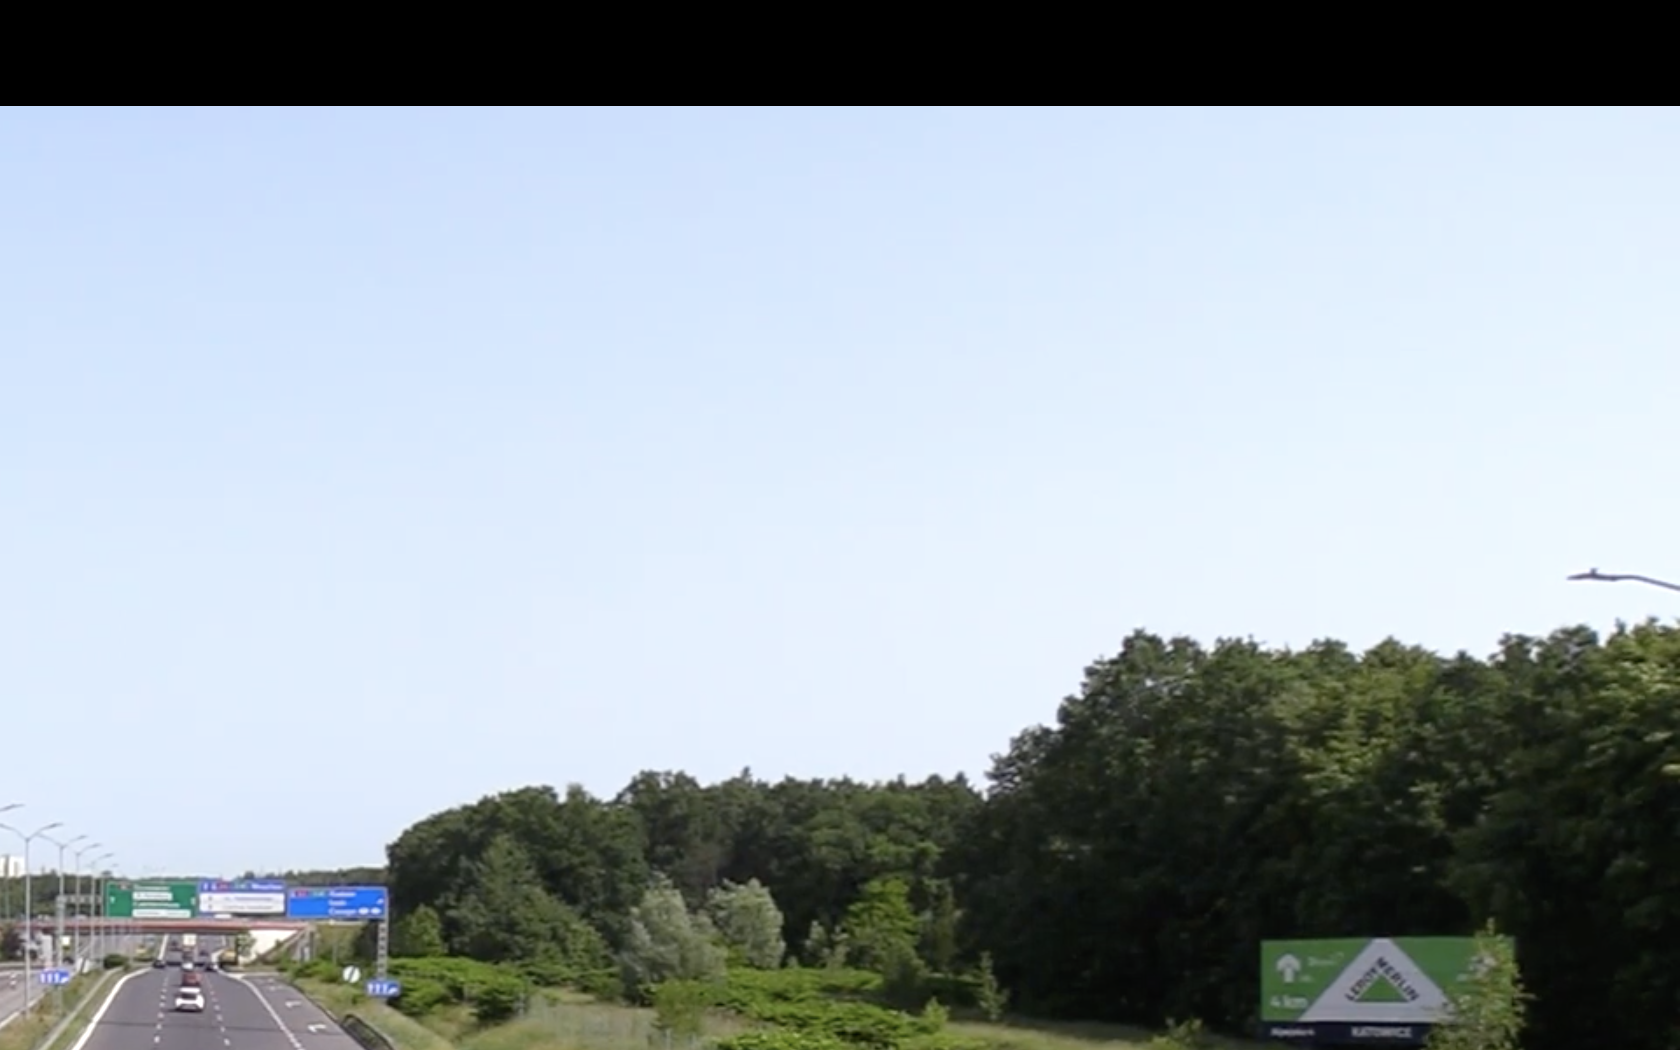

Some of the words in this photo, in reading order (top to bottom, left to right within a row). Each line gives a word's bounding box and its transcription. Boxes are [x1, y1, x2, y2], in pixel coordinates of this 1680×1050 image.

[1344, 966, 1378, 1001] LEROY
[1376, 956, 1420, 1001] MERLIN
[1351, 1026, 1413, 1037] KATOWICE
